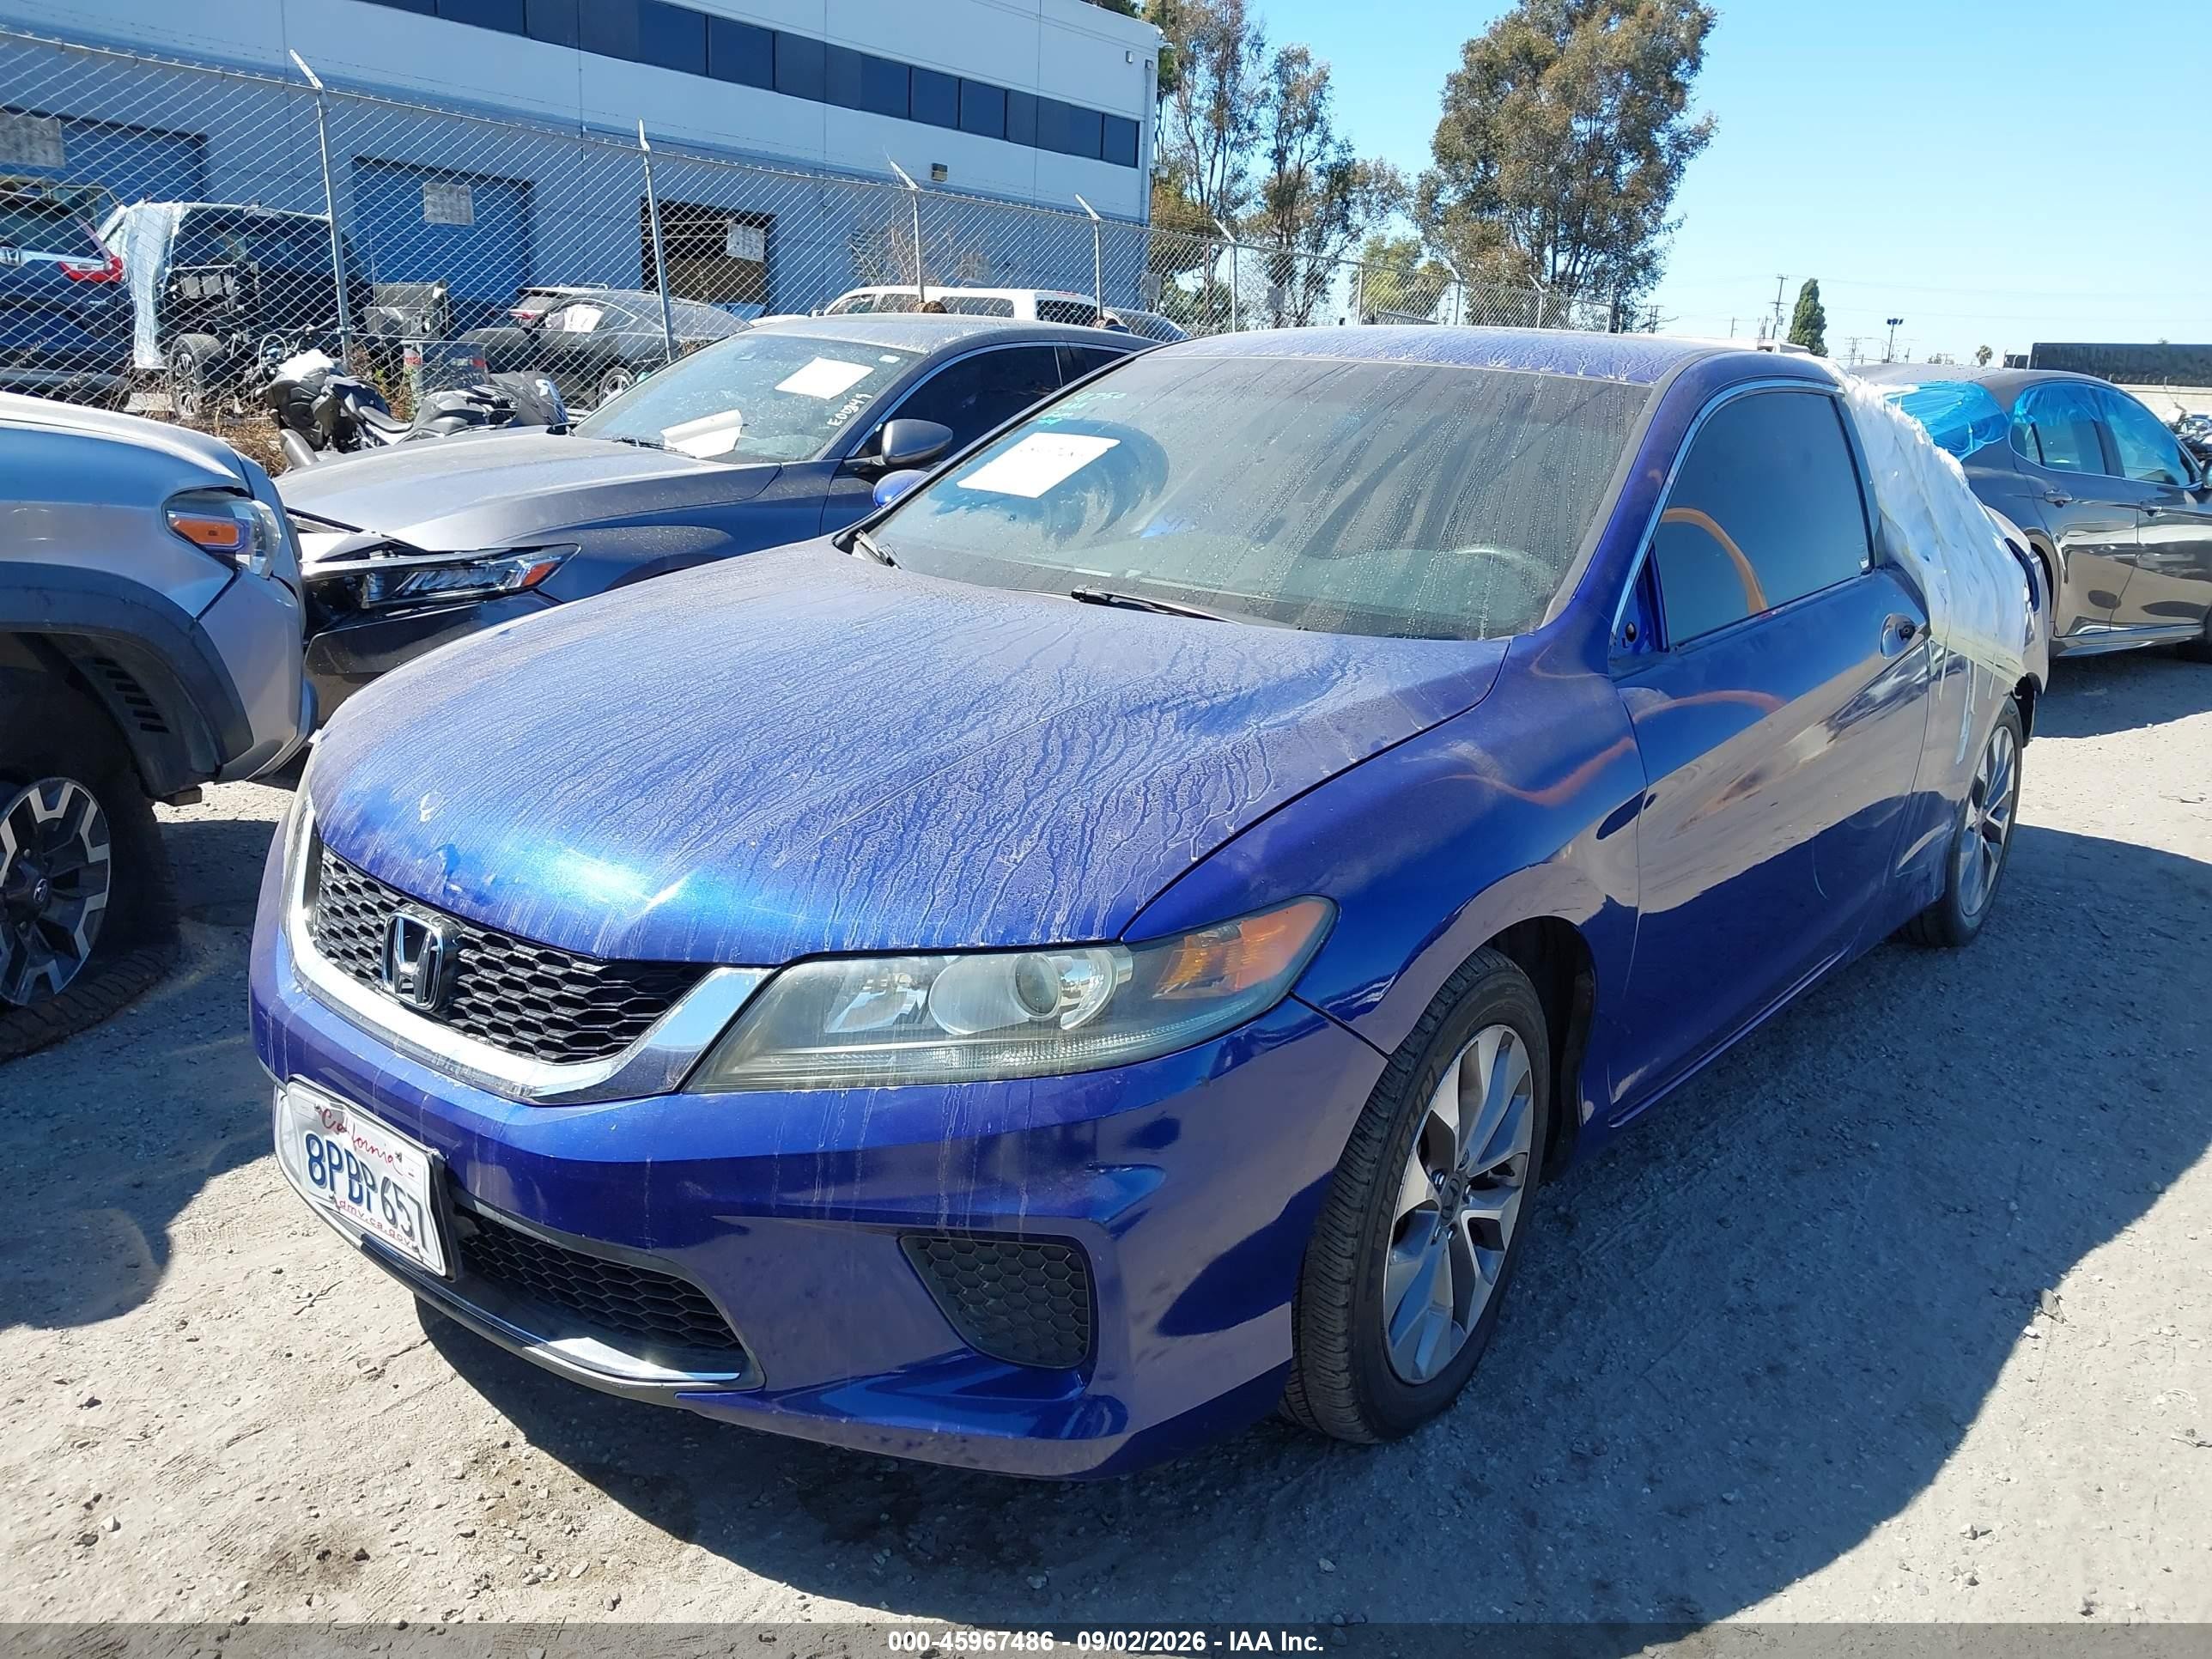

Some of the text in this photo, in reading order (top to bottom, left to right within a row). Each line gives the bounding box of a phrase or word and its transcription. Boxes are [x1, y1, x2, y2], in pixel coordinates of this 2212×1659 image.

[321, 1109, 404, 1176] Cafornia
[305, 1132, 429, 1254] 8PBP657
[338, 1199, 411, 1248] dmv.ca.gov
